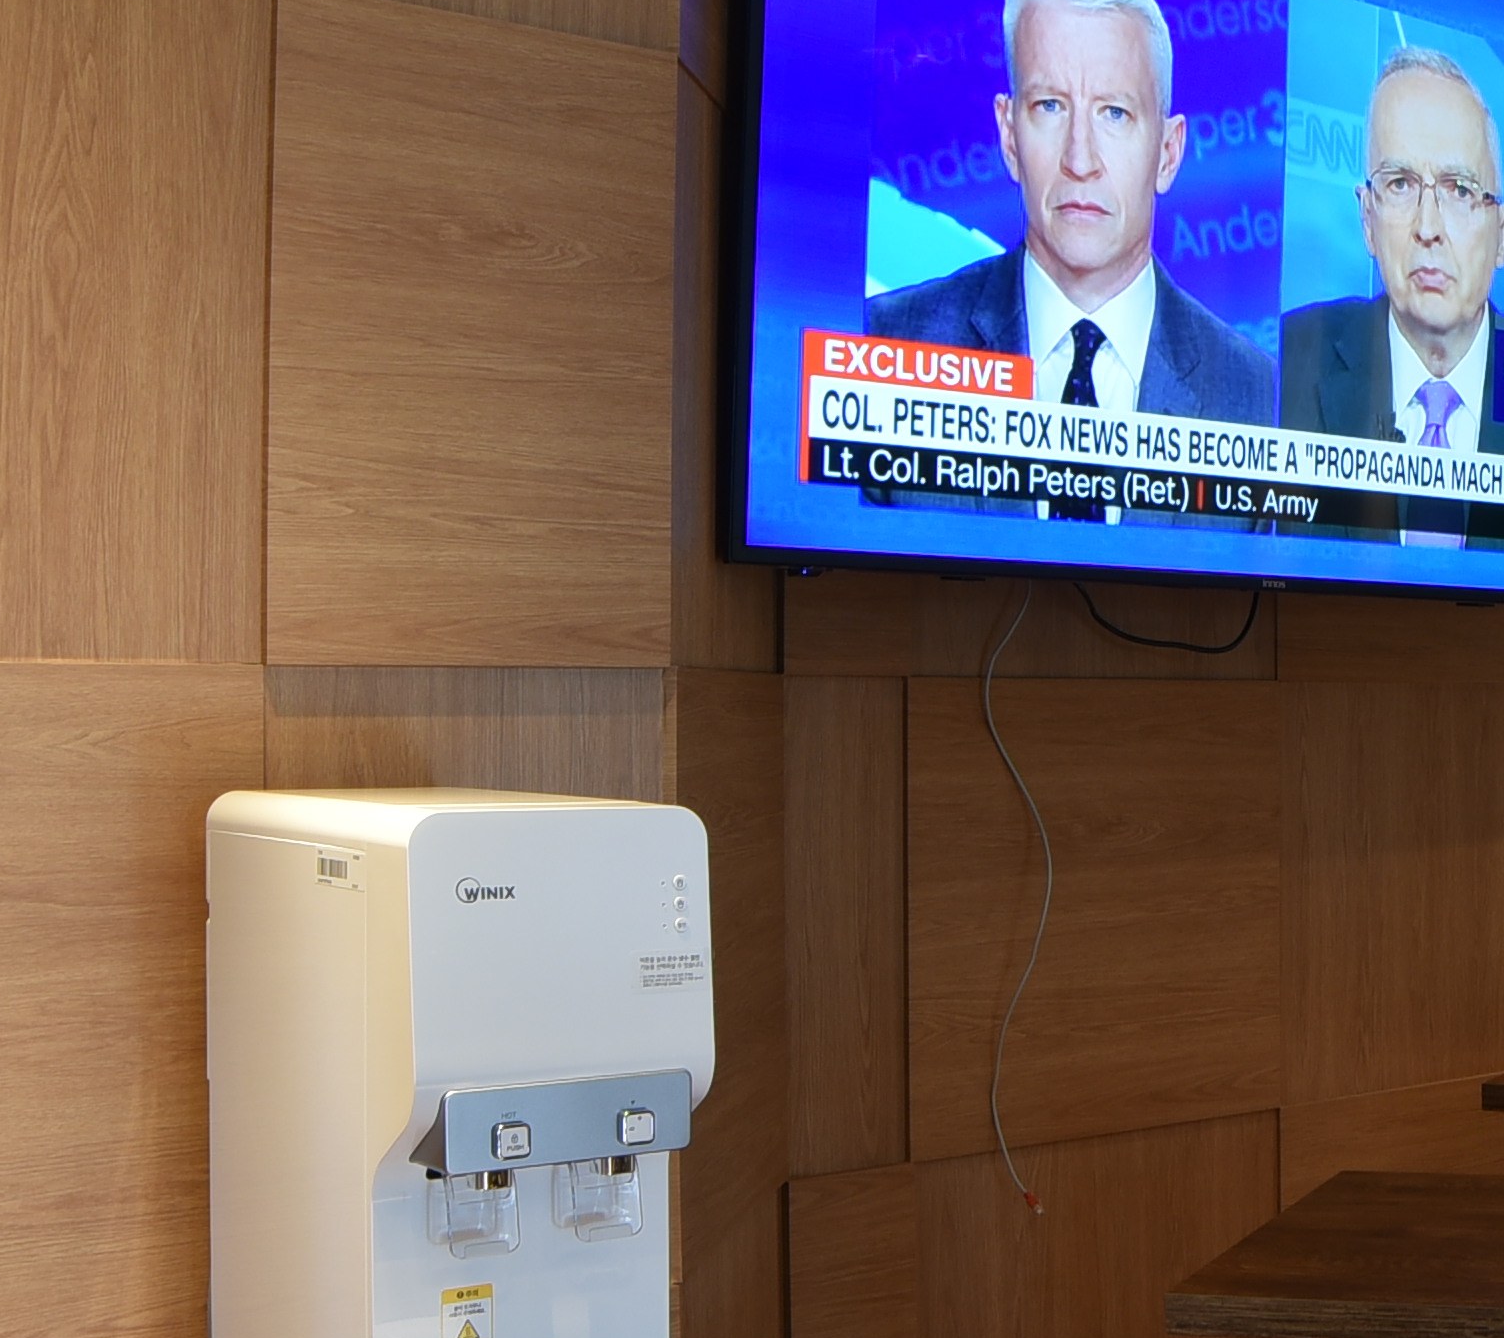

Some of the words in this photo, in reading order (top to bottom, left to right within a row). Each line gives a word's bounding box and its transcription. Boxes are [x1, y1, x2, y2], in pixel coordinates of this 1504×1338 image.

[1172, 204, 1281, 261] Ande
[823, 338, 1014, 392] EXCLUSIVE
[822, 390, 883, 433] COL.
[894, 397, 996, 444] PETERS:
[1005, 410, 1052, 449] FOX
[1060, 415, 1129, 457] NEWS
[1137, 424, 1181, 463] HAS
[1189, 429, 1278, 472] BECOME
[1285, 442, 1298, 475] A
[1306, 442, 1445, 490] "PROPAGANDA
[823, 444, 860, 480] Lt.
[869, 449, 926, 485] Col.
[936, 455, 1020, 497] Ralph
[1029, 463, 1117, 500] Peters
[1123, 470, 1190, 513] (Ret.)
[1215, 485, 1257, 513] U.S.
[1262, 488, 1319, 523] Army
[456, 876, 516, 904] WINIX
[501, 1111, 517, 1120] HOT
